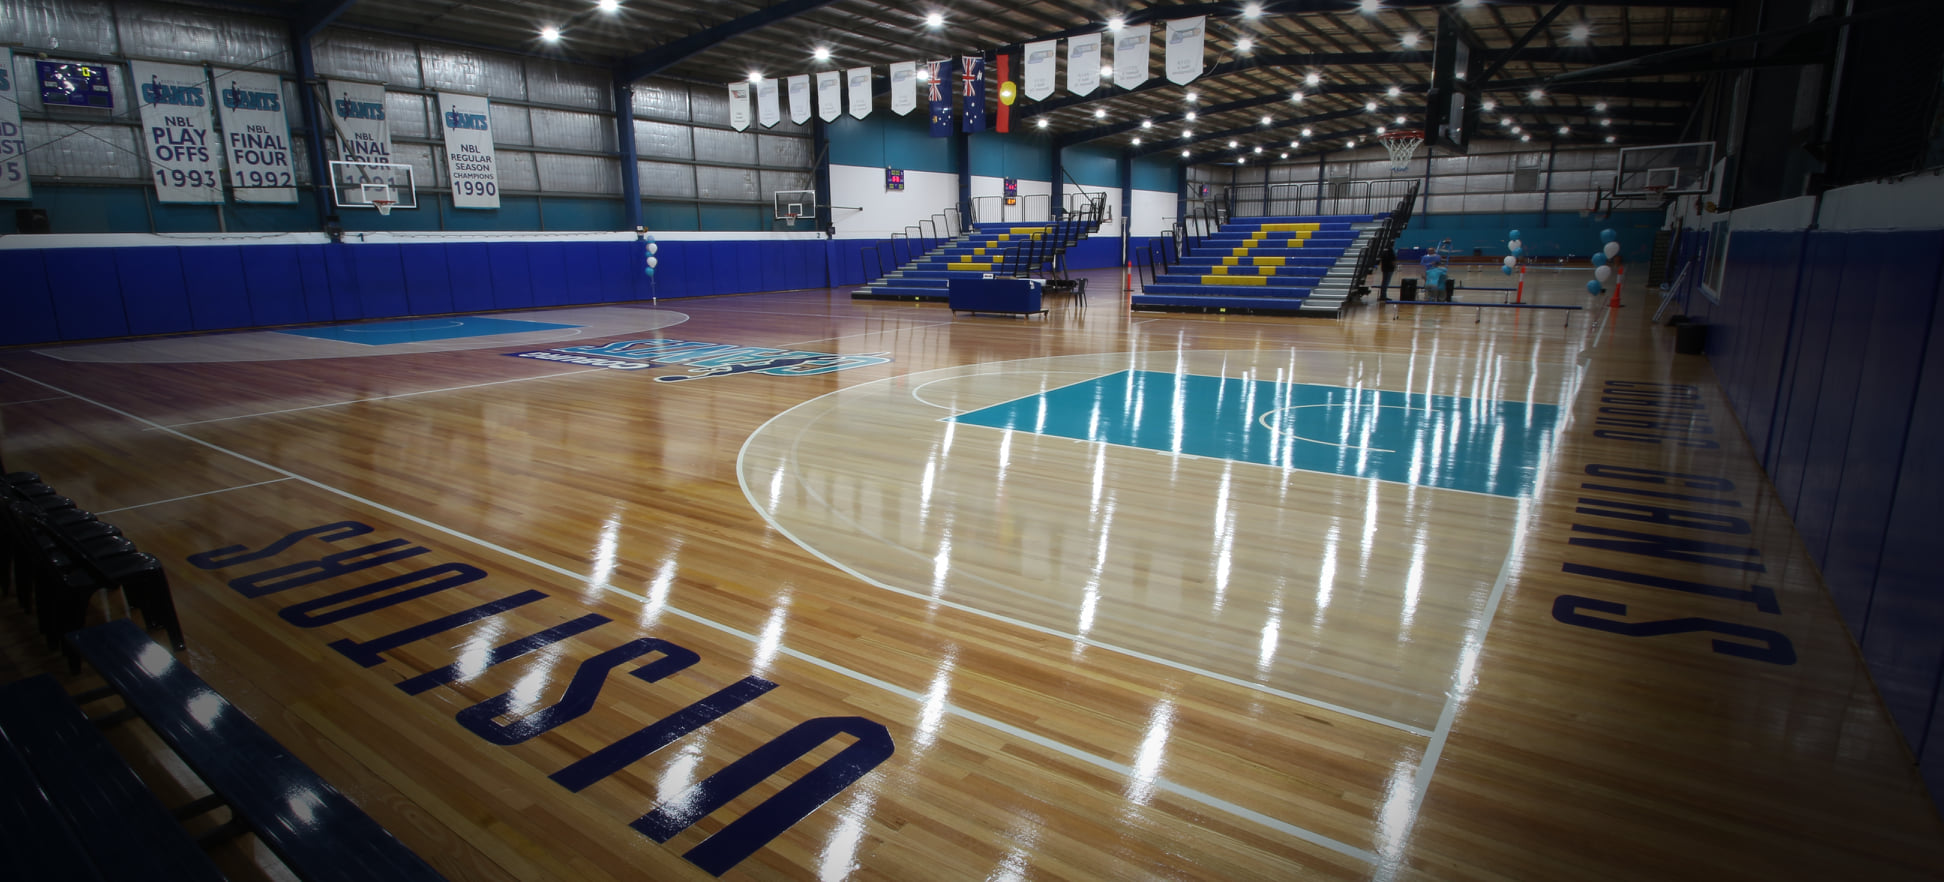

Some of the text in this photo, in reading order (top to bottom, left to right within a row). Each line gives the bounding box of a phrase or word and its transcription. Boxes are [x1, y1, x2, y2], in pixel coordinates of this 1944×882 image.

[142, 83, 205, 107] GIANTS
[222, 89, 281, 112] GIANTS
[335, 99, 385, 120] GIANTS
[0, 121, 18, 137] D
[165, 116, 194, 128] NBL
[247, 124, 270, 134] NBL
[445, 111, 488, 131] GIANTS
[152, 127, 207, 146] PLAY
[230, 132, 287, 151] FINAL
[354, 132, 374, 140] NBL
[0, 139, 25, 155] ST
[156, 145, 209, 162] OFFS
[460, 143, 481, 154] NBL
[234, 149, 288, 166] FOUR
[451, 153, 492, 163] REGULAR
[453, 171, 494, 180] CHAMPIONS
[455, 162, 490, 172] SEASON
[156, 169, 216, 188] 1993
[236, 170, 291, 187] 1992
[454, 180, 496, 196] 1990
[1552, 379, 1798, 666] COBURG GIANTS
[186, 520, 896, 877] VISITORS
